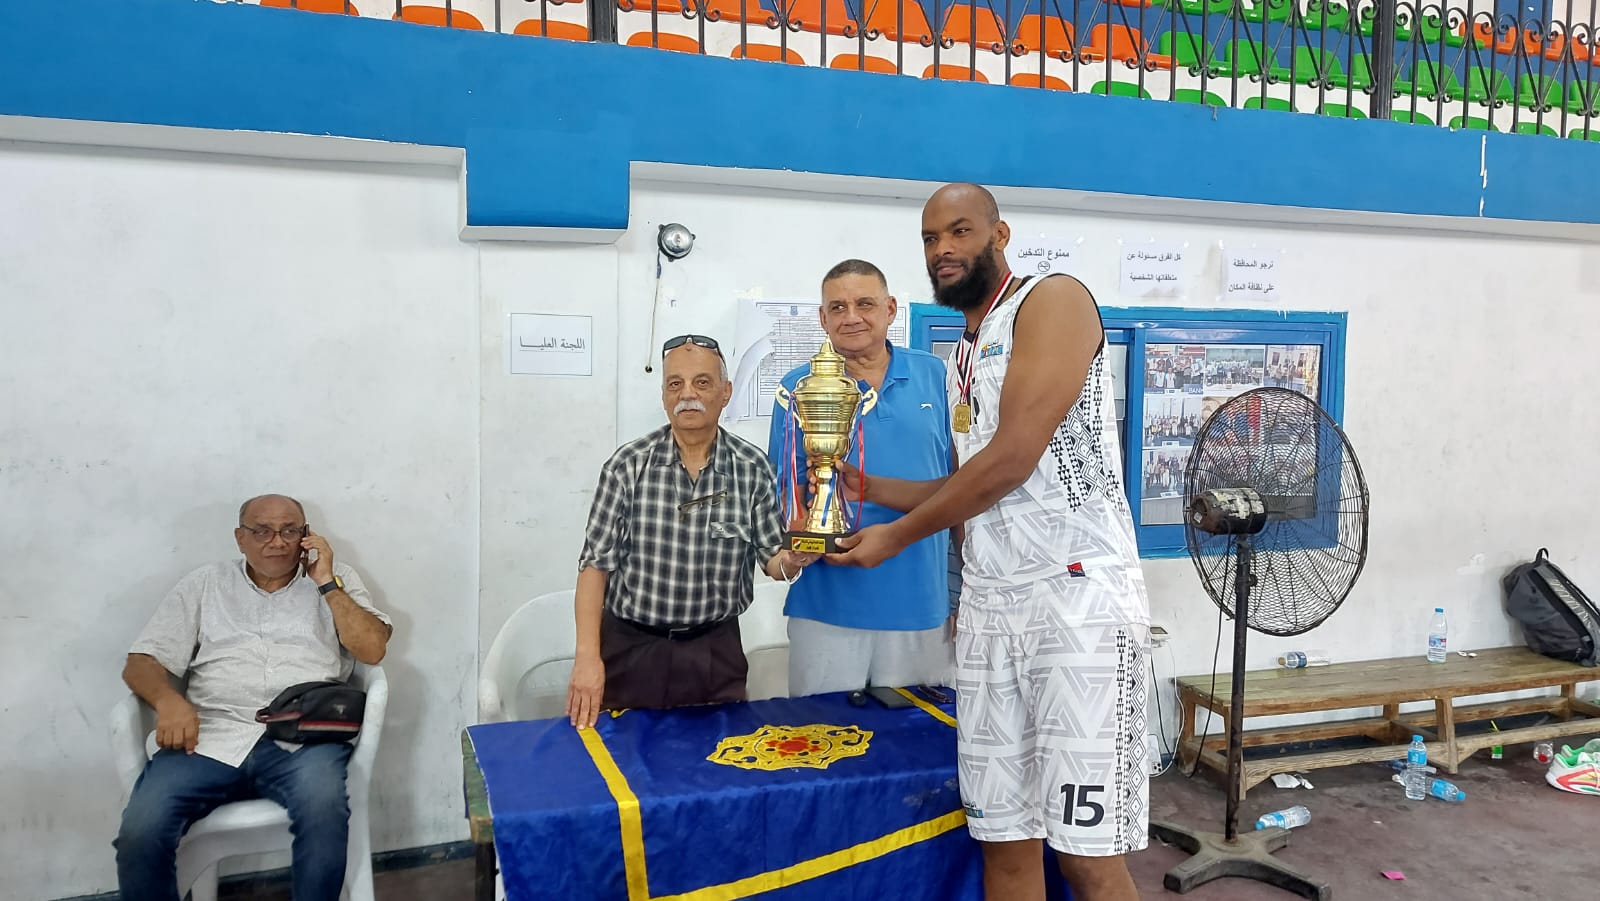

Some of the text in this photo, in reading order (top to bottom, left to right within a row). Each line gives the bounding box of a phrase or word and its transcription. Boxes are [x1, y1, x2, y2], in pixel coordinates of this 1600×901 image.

[1018, 247, 1070, 260] ممنوع التدخين
[1126, 252, 1136, 261] عن
[1158, 251, 1173, 262] الفرق
[1174, 251, 1182, 262] كل
[1233, 259, 1274, 270] نرجو المحافظة
[1129, 272, 1154, 282] الشخصية
[1228, 281, 1275, 293] على نظافة المكان
[560, 336, 586, 351] اللجنة
[1060, 783, 1105, 828] 15
